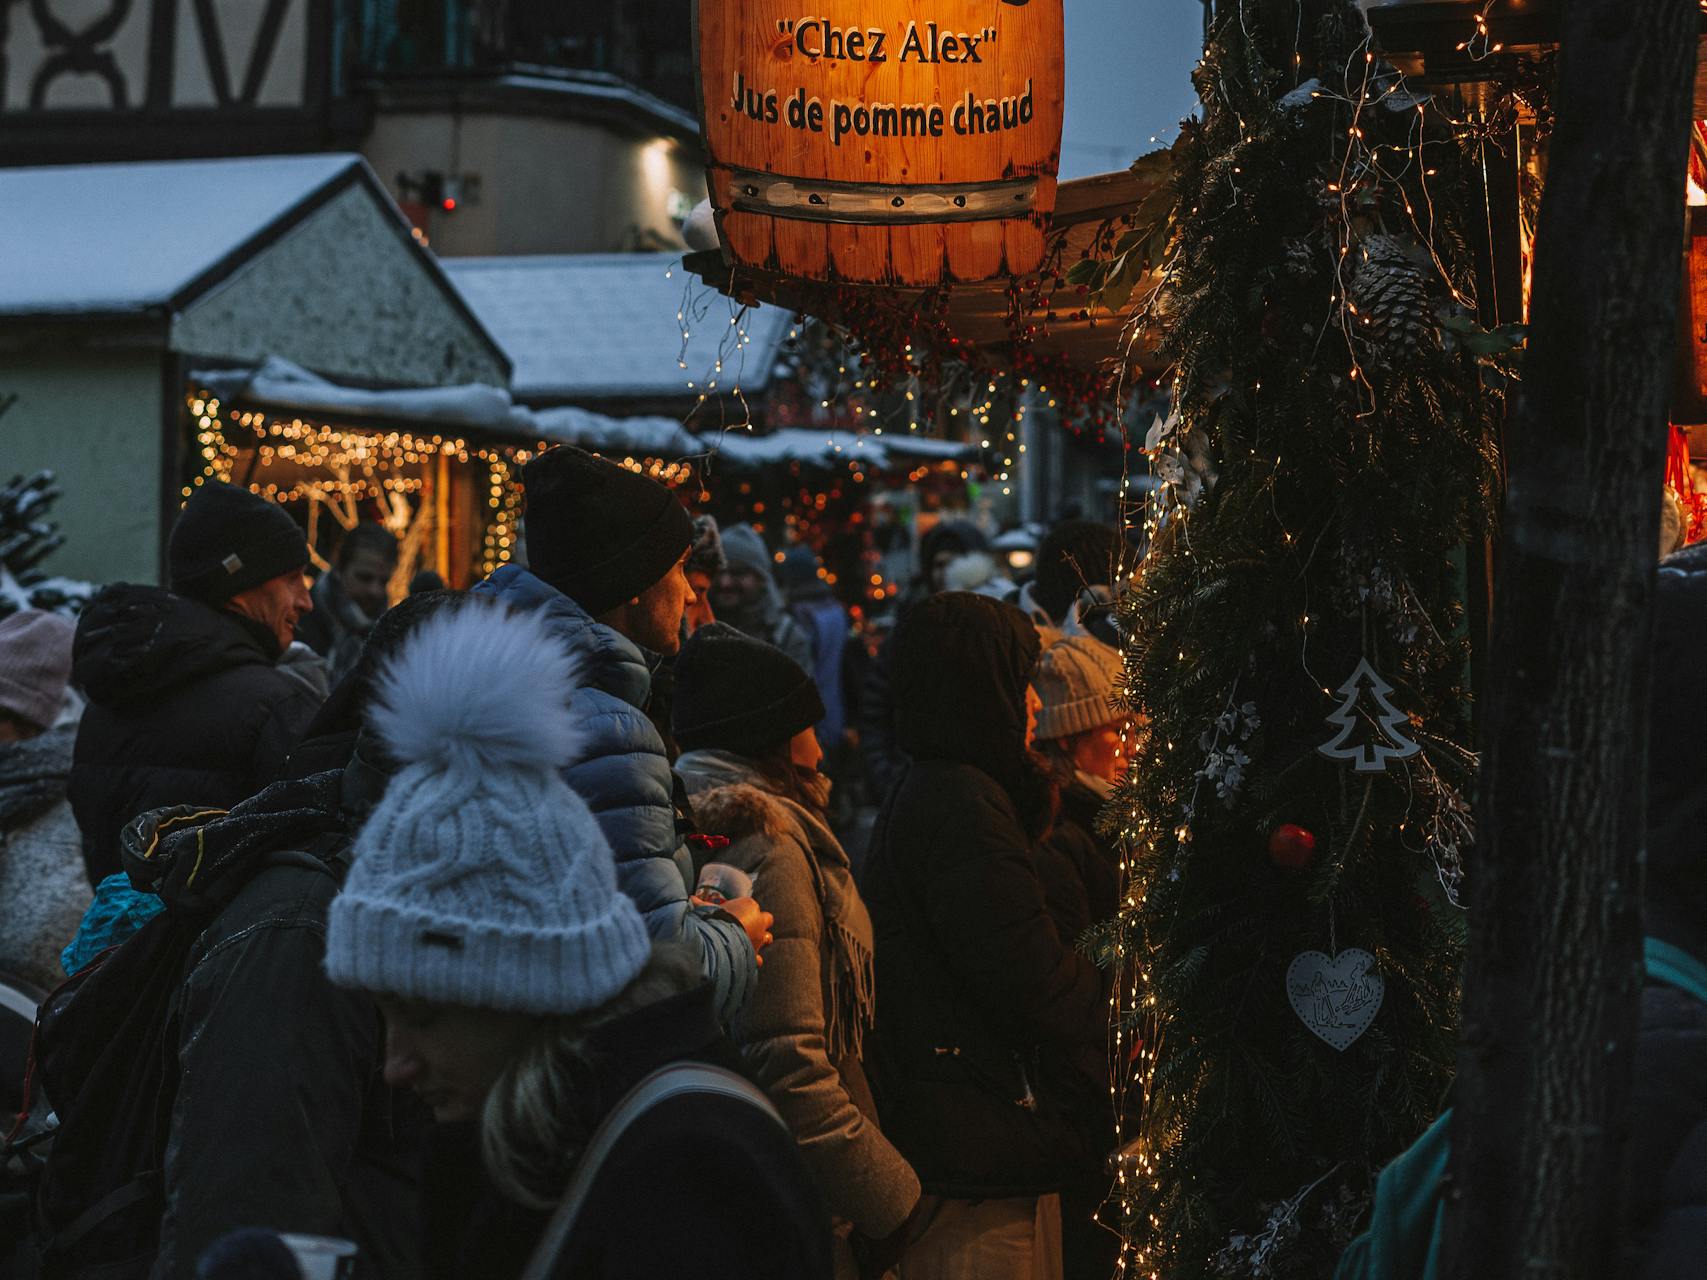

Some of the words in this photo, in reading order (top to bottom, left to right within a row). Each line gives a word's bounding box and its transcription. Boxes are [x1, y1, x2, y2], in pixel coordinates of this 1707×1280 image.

[777, 18, 887, 62] "Chez
[899, 21, 997, 63] Alex"
[732, 72, 778, 123] Jus
[784, 88, 823, 132] de
[830, 97, 944, 145] pomme
[951, 77, 1033, 135] chaud
